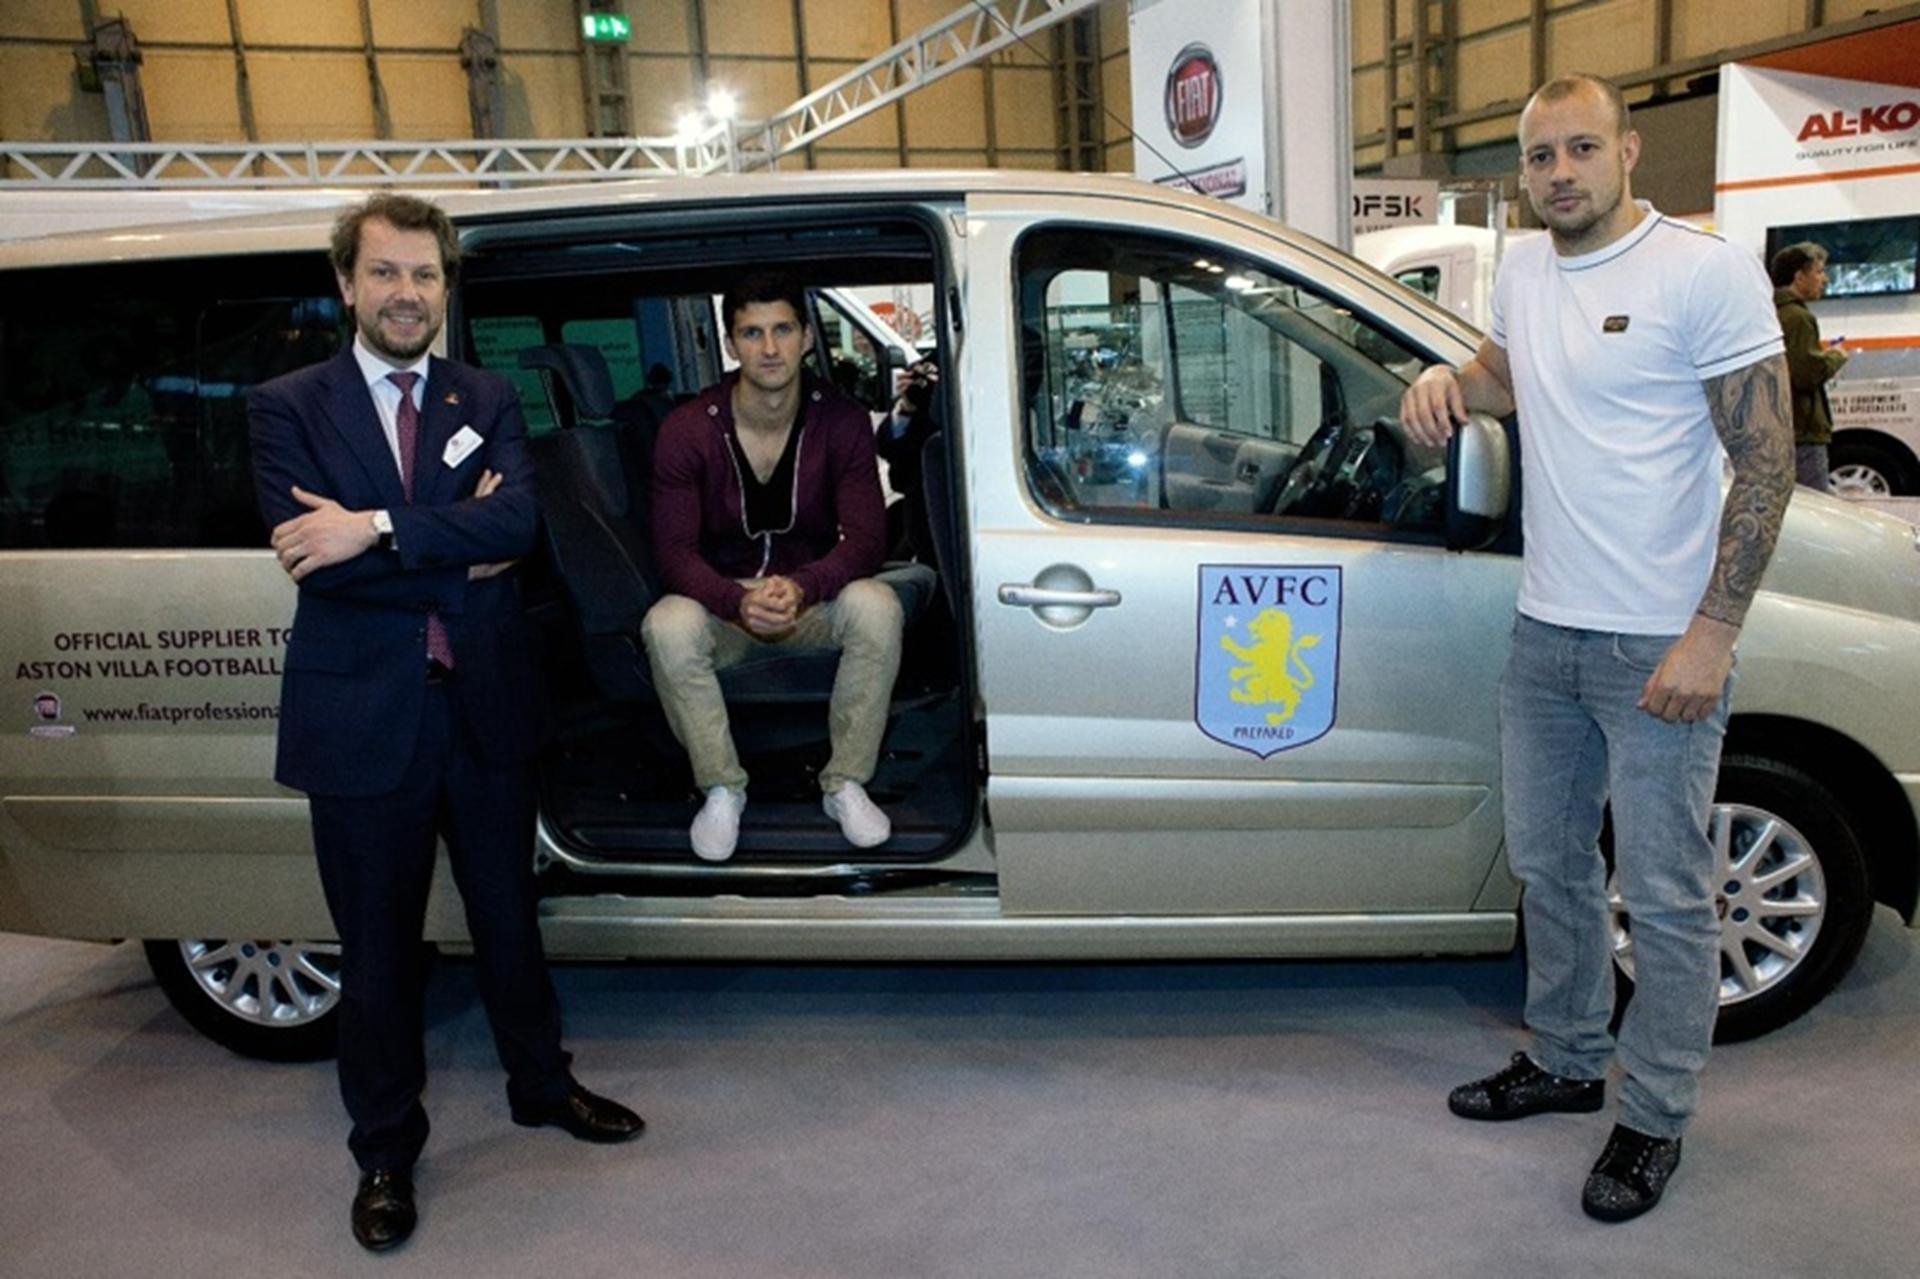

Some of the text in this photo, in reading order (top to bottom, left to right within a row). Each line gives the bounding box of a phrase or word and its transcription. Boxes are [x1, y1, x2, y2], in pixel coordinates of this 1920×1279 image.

[1177, 70, 1210, 123] FIAT
[1796, 101, 1920, 141] AL-KO
[1796, 139, 1918, 160] QUALITY FOR LIFE
[1212, 575, 1328, 606] AVFC
[54, 631, 152, 651] OFFICIAL
[157, 629, 261, 649] SUPPLIER
[16, 658, 284, 680] ASTON VILLA FOOTBALL
[1233, 725, 1294, 740] PREPARED
